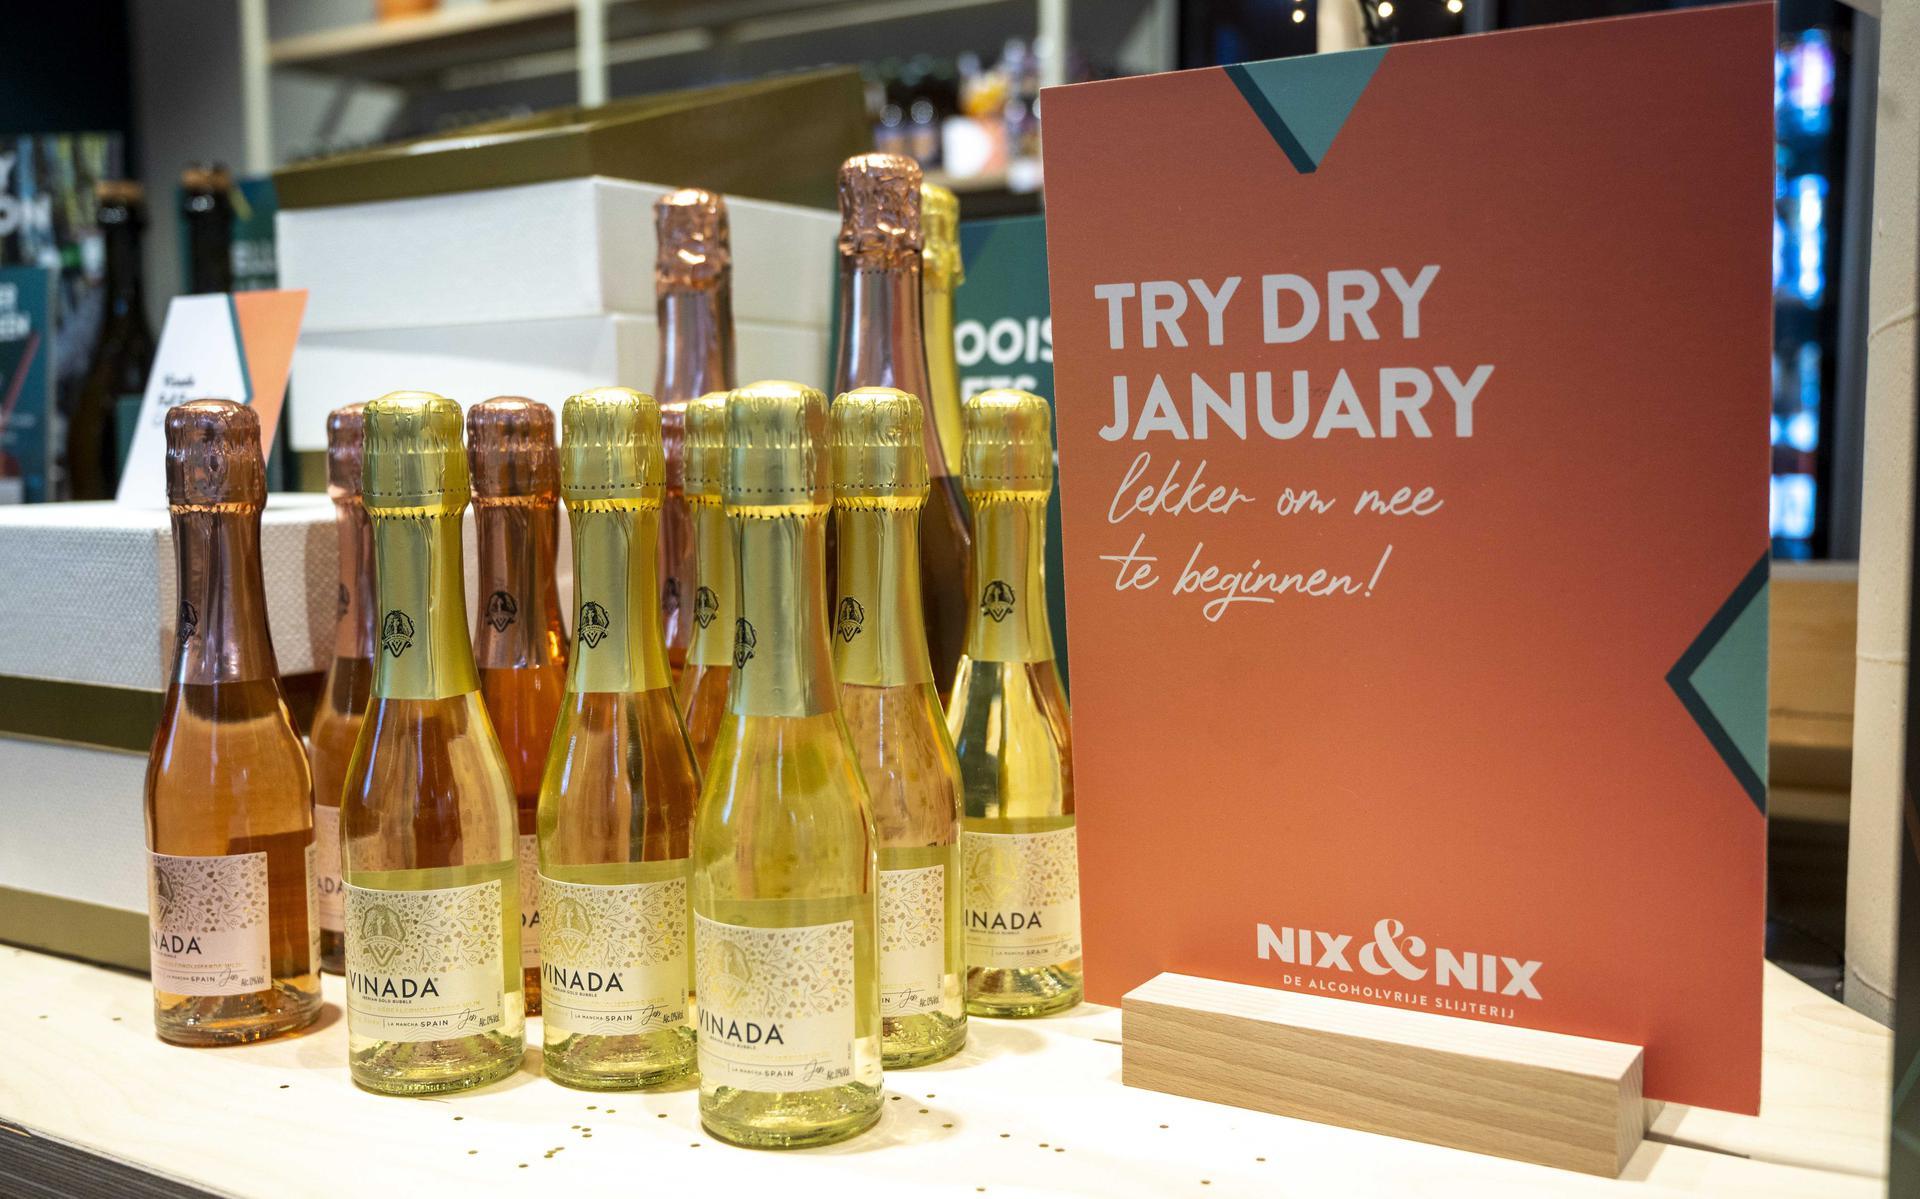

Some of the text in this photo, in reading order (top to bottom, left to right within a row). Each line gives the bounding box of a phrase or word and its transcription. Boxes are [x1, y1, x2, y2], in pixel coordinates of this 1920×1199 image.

[1094, 265, 1440, 350] TRY DRY
[1098, 364, 1495, 442] JANUARY
[1108, 452, 1444, 524] lekker om mee
[1100, 533, 1393, 622] te beginnen!
[965, 909, 1042, 930] INADA
[152, 931, 202, 955] NADA
[1256, 918, 1543, 1000] NIX & NIX
[190, 975, 215, 983] SPAIN
[349, 970, 439, 998] VINADA
[542, 960, 624, 992] VINADA
[1283, 974, 1515, 1019] DE ALCOHOLVRIJE SLIJTERIJ
[420, 1019, 449, 1028] SPAIN
[698, 1006, 784, 1045] VINADA
[764, 1069, 794, 1078] SPAIN
